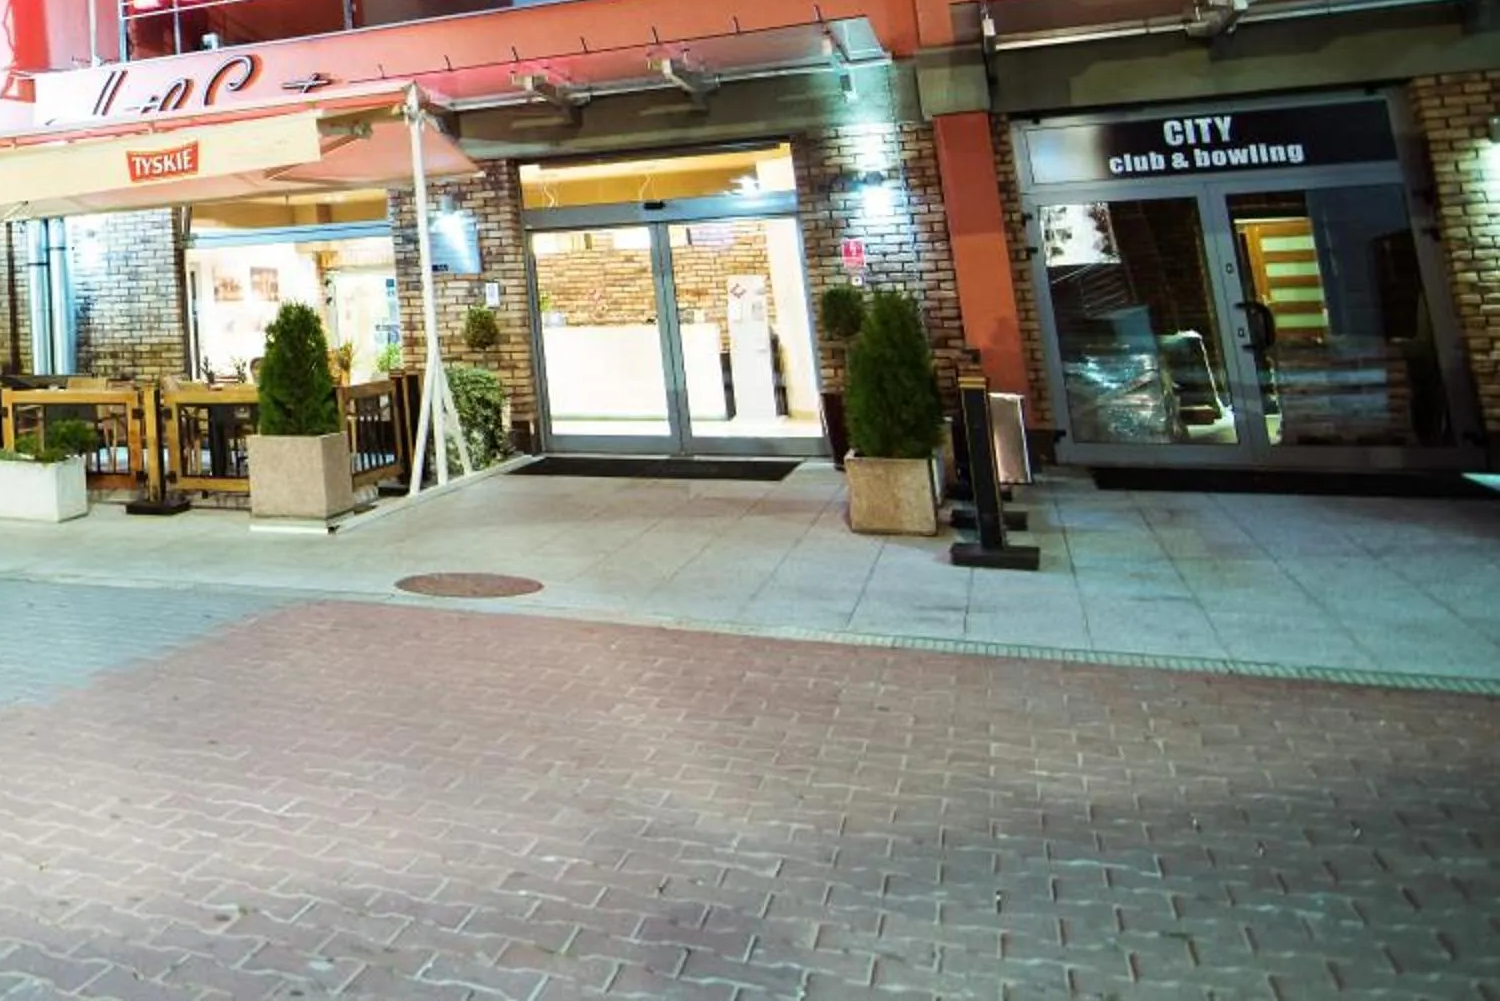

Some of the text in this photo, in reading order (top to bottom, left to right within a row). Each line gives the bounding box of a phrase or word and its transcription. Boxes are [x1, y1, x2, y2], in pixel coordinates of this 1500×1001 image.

[1163, 115, 1232, 146] CITY
[131, 149, 194, 177] TYSKIE
[1108, 143, 1304, 174] club & bowling
